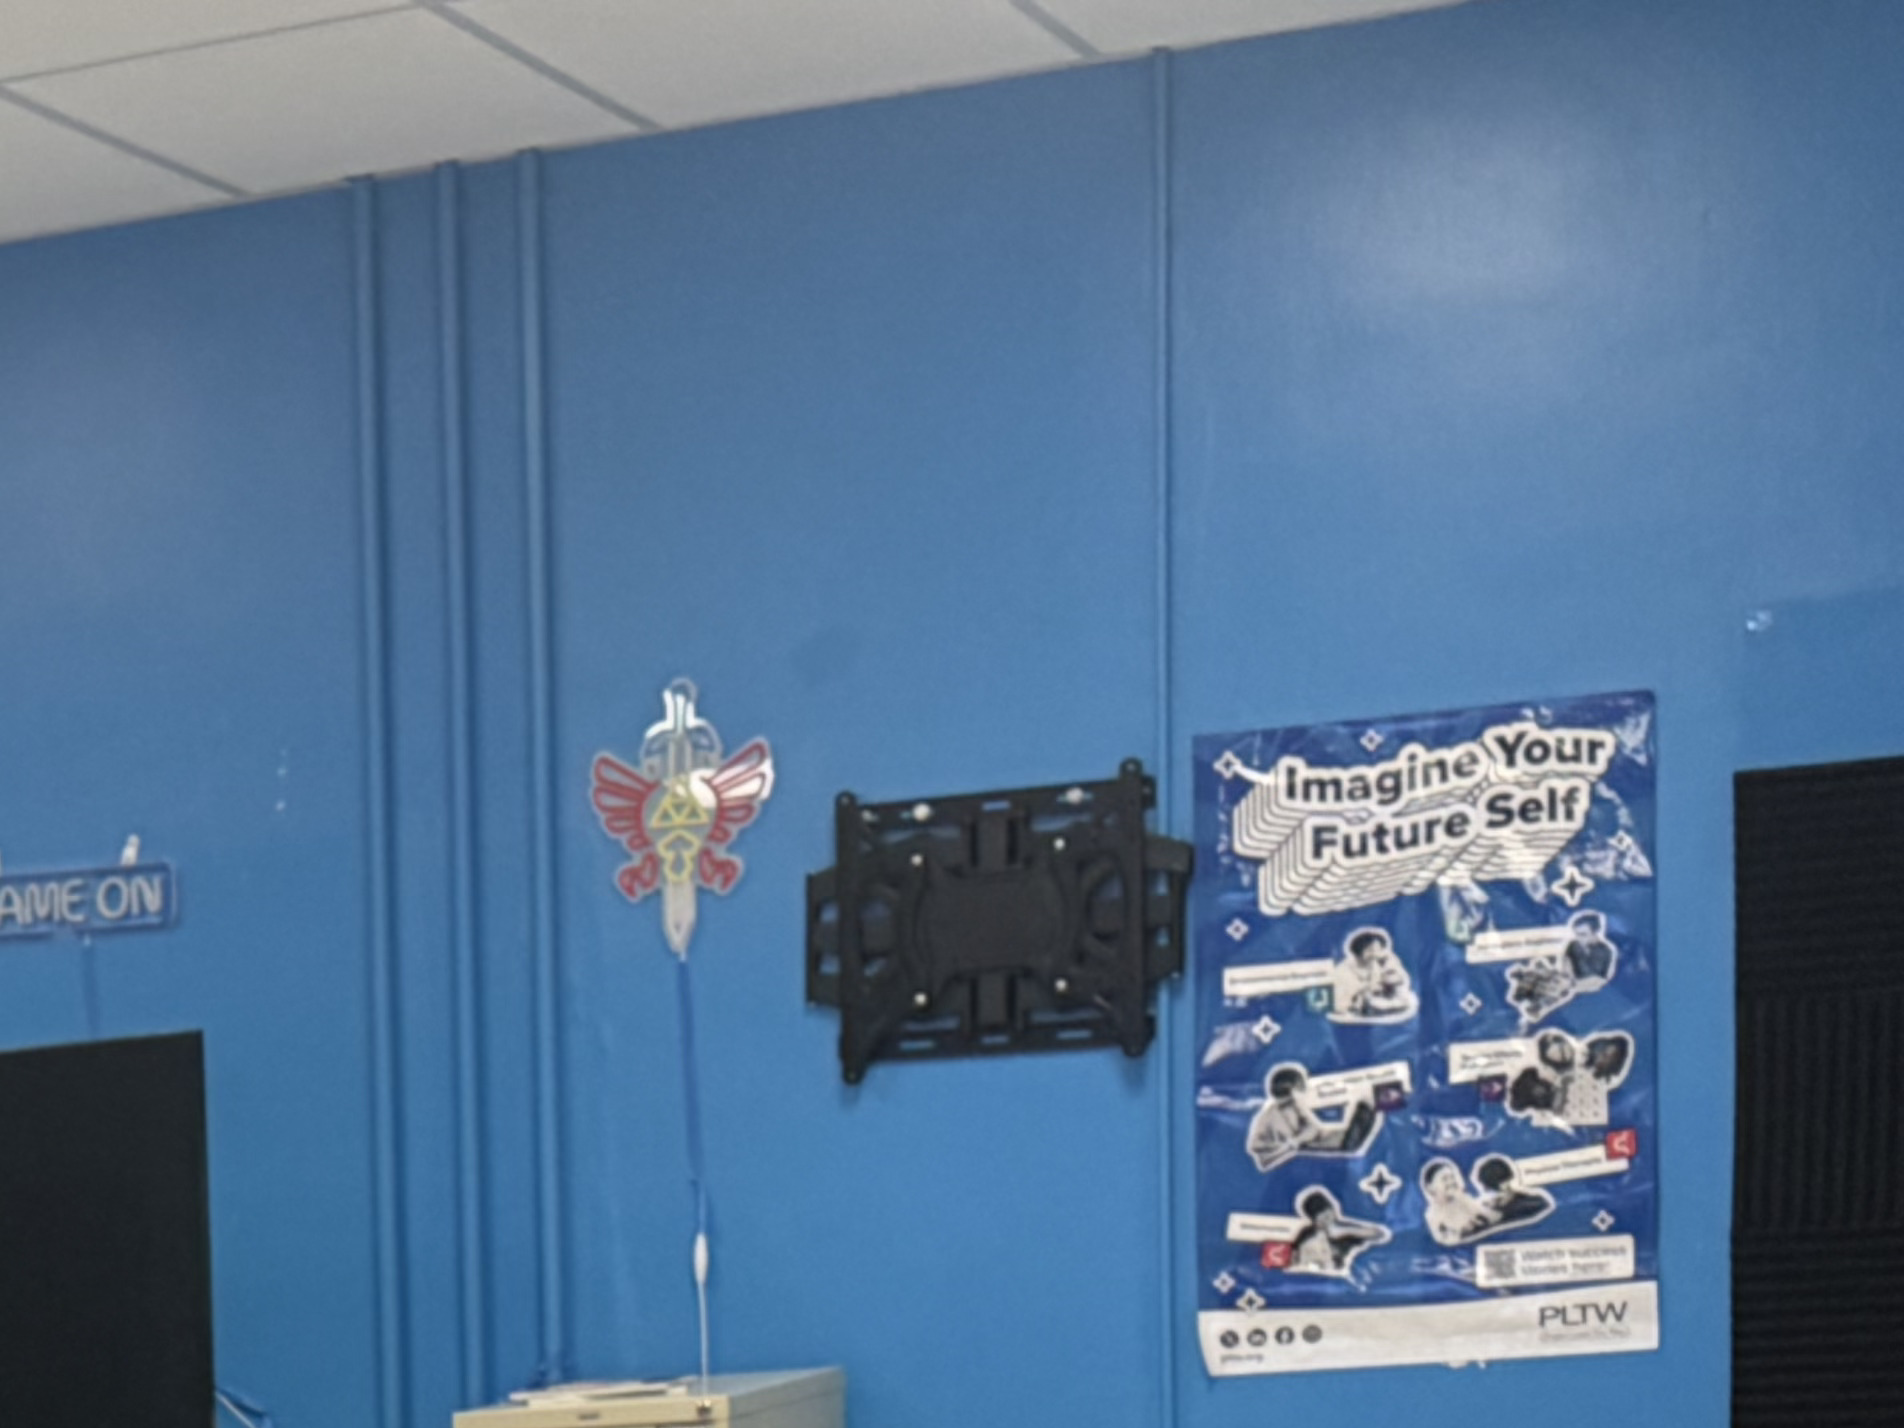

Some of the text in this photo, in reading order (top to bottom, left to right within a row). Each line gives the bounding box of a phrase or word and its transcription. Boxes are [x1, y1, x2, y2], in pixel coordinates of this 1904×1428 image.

[1285, 731, 1605, 806] Imagine Your
[1312, 786, 1580, 860] Future Self
[96, 876, 163, 920] ON
[1538, 1301, 1627, 1327] PLTW
